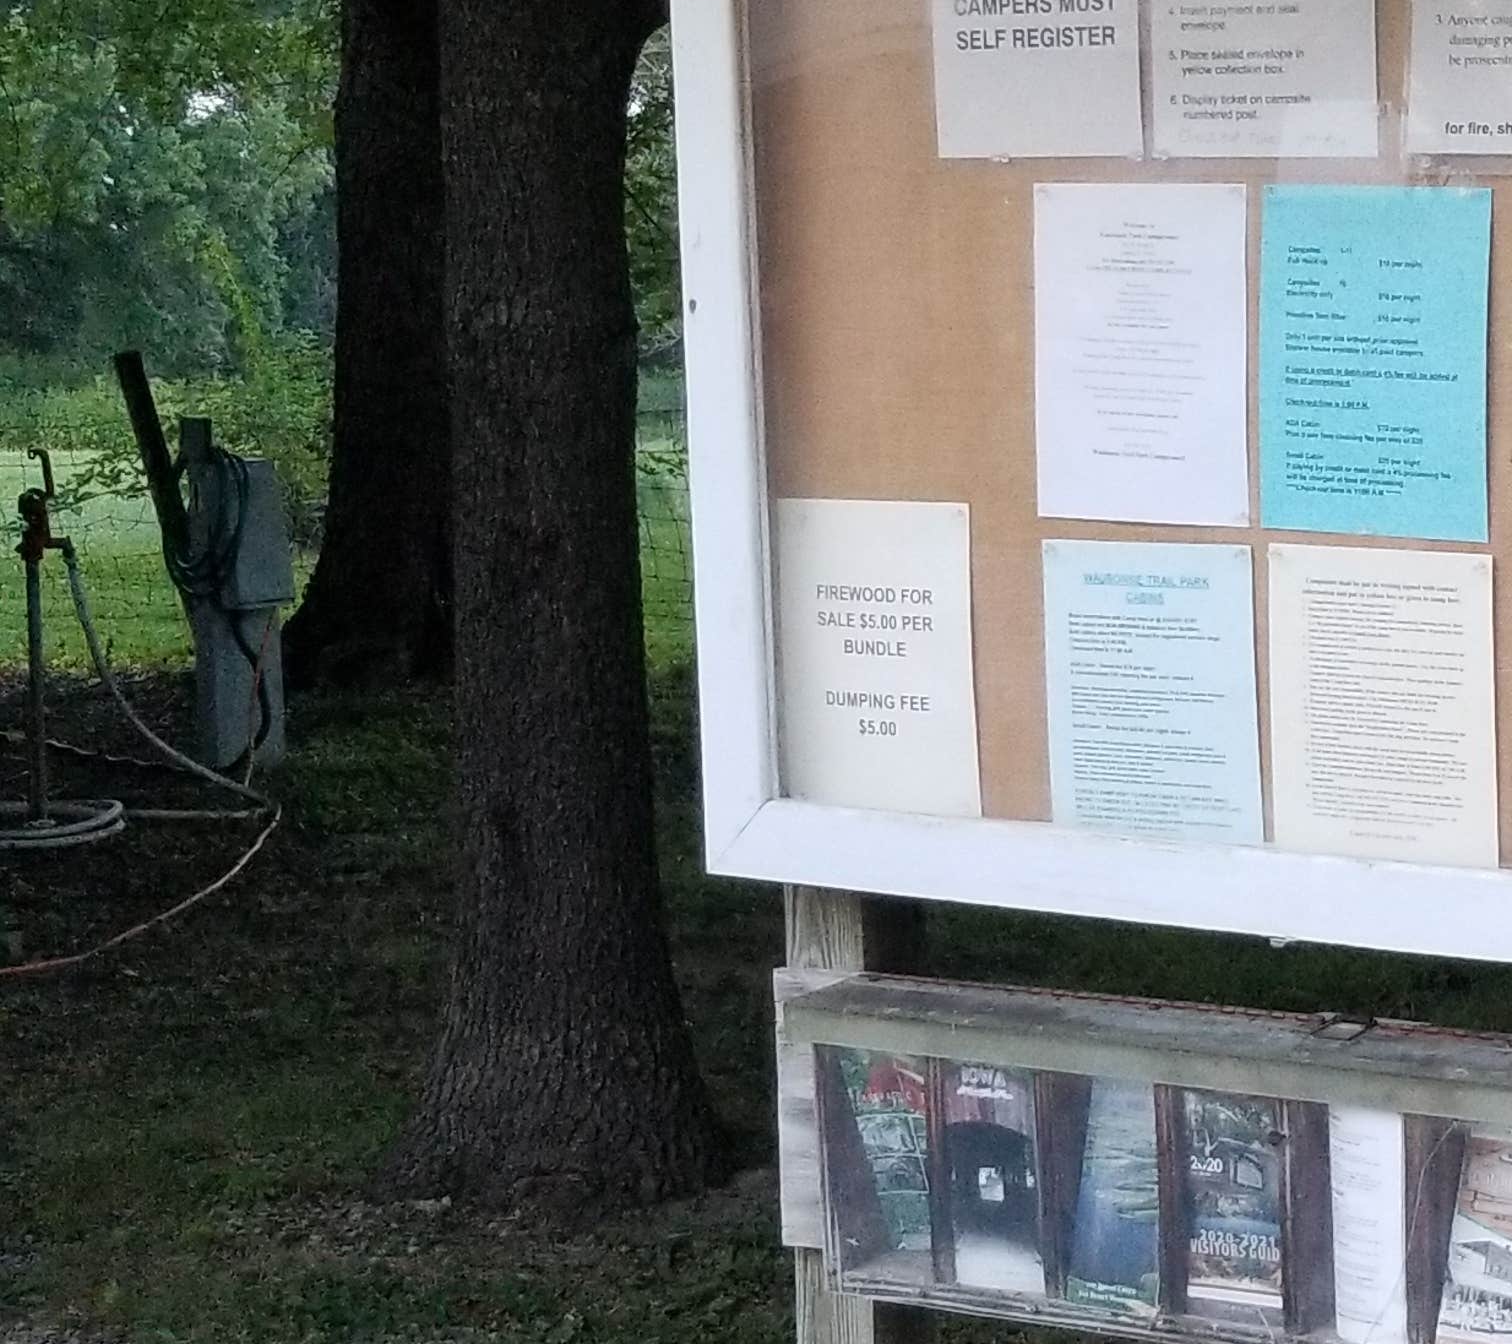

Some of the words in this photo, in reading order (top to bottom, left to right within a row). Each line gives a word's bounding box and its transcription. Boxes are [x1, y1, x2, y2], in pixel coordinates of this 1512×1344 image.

[956, 28, 1006, 50] SELF
[1012, 26, 1116, 49] REGISTER
[1445, 123, 1464, 135] for
[1467, 122, 1493, 136] fire,
[816, 584, 896, 603] FIREWOOD
[901, 589, 933, 605] FOR
[817, 611, 856, 628] SALE
[860, 613, 897, 630] $5.00
[902, 616, 933, 632] PER
[844, 639, 906, 657] BUNDLE
[826, 690, 894, 710] DUMPING
[900, 696, 930, 711] FEE
[859, 719, 897, 737] $5.00
[1190, 1237, 1247, 1258] VISITORS
[1200, 1228, 1276, 1248] 2020-2021
